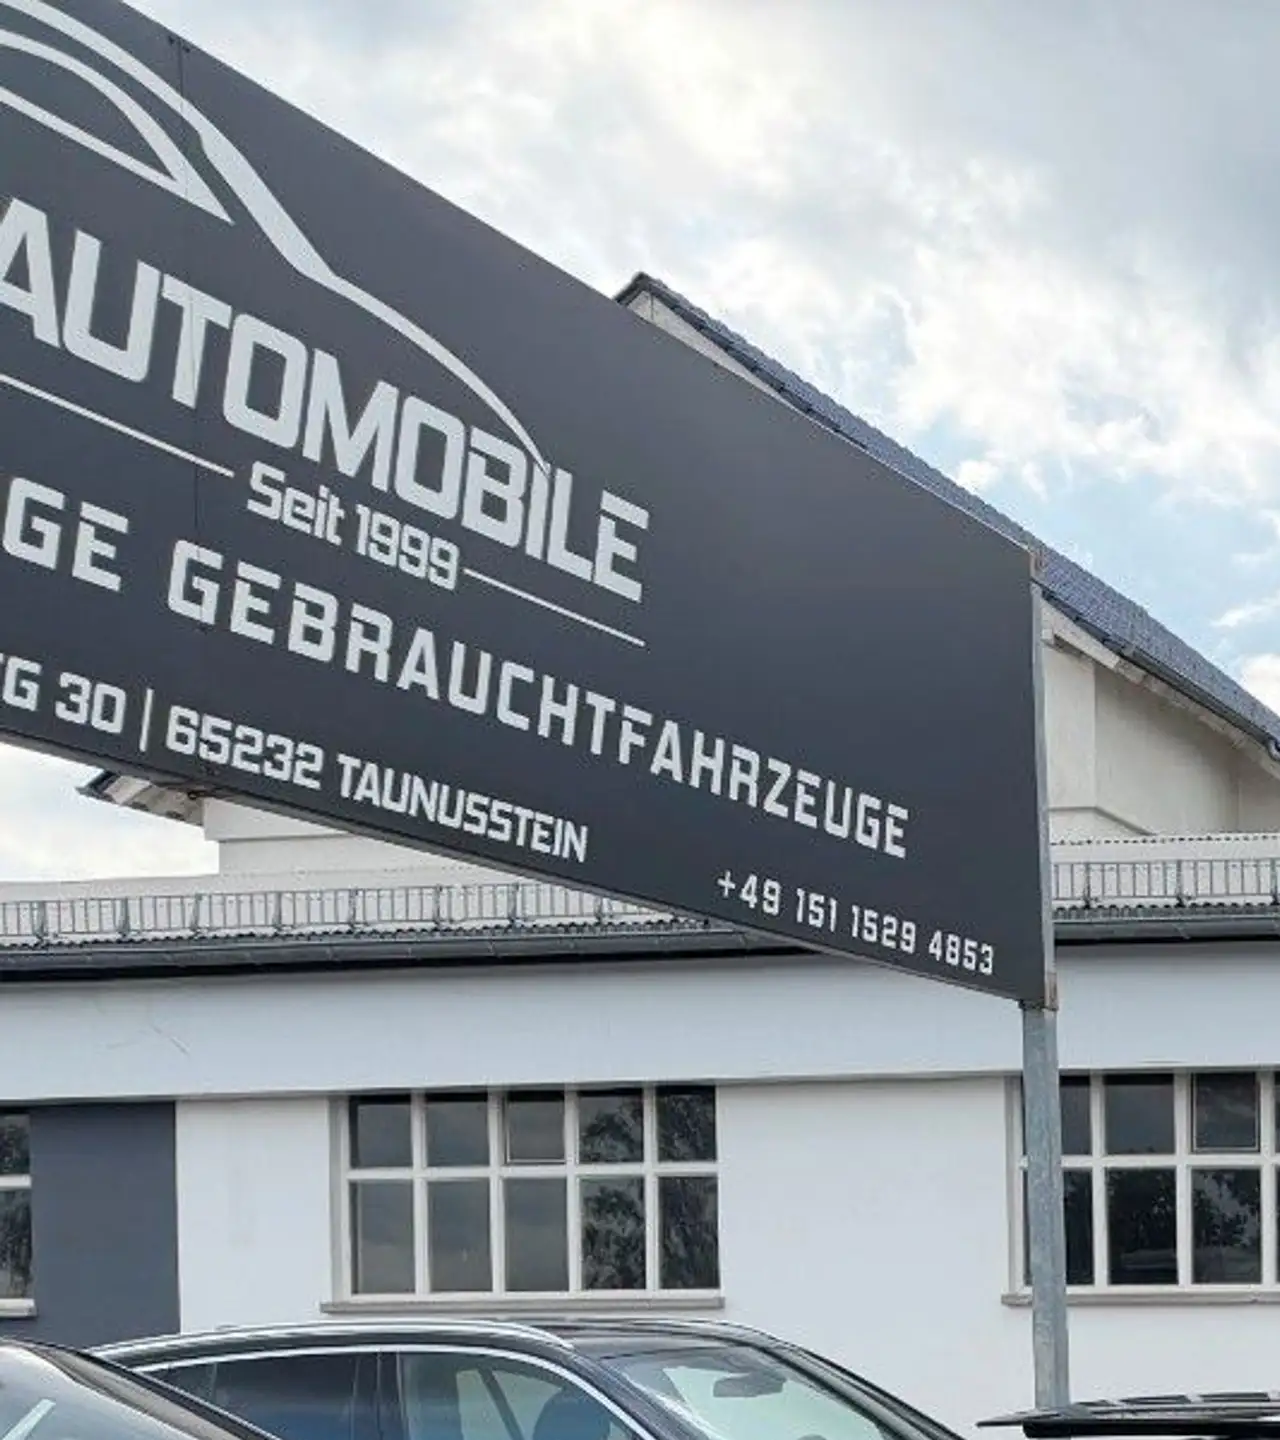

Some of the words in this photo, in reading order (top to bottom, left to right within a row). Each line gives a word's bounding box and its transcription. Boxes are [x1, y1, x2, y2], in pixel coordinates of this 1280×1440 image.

[0, 197, 649, 603] AUTOMOBILE
[247, 460, 345, 546] Seit
[355, 503, 460, 591] 1999
[55, 671, 127, 734] 30
[165, 705, 323, 791] 65232
[337, 753, 587, 864] TAUNUSSTEIN
[168, 539, 908, 858] GEBRAUCHTFAHRZEUGE
[716, 870, 782, 916] +49
[796, 888, 837, 932] 151
[851, 905, 916, 954] 1529
[928, 930, 994, 975] 4853
